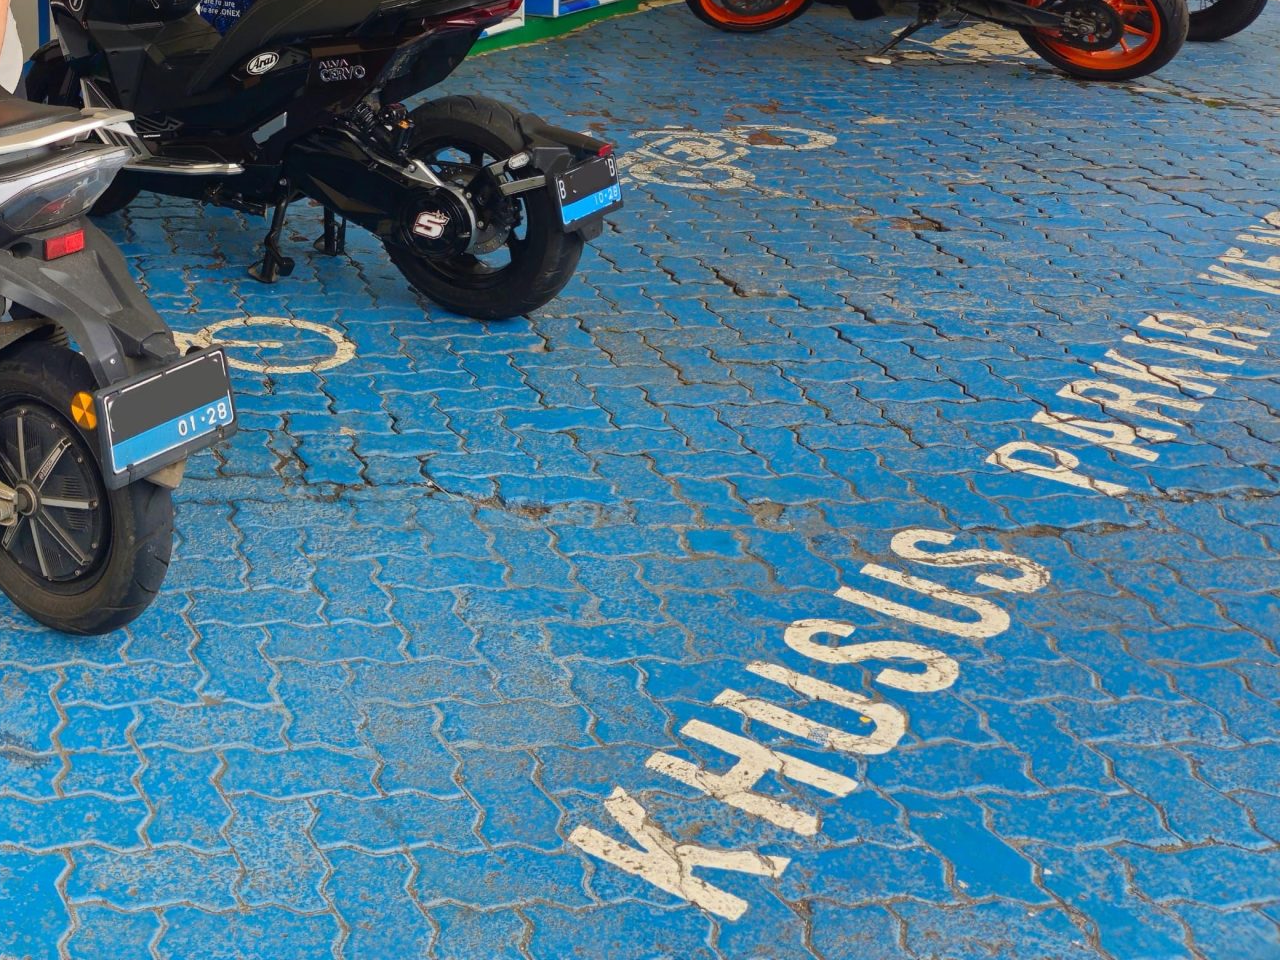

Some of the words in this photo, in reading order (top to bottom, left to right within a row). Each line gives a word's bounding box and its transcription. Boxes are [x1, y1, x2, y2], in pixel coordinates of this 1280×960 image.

[220, 8, 240, 18] ONEX
[252, 54, 275, 69] Arai
[319, 58, 349, 69] ALVA
[320, 64, 366, 82] CERVO
[558, 180, 567, 199] B
[607, 158, 616, 177] B
[567, 529, 1051, 921] KHUSUS
[986, 311, 1270, 496] PARKIR
